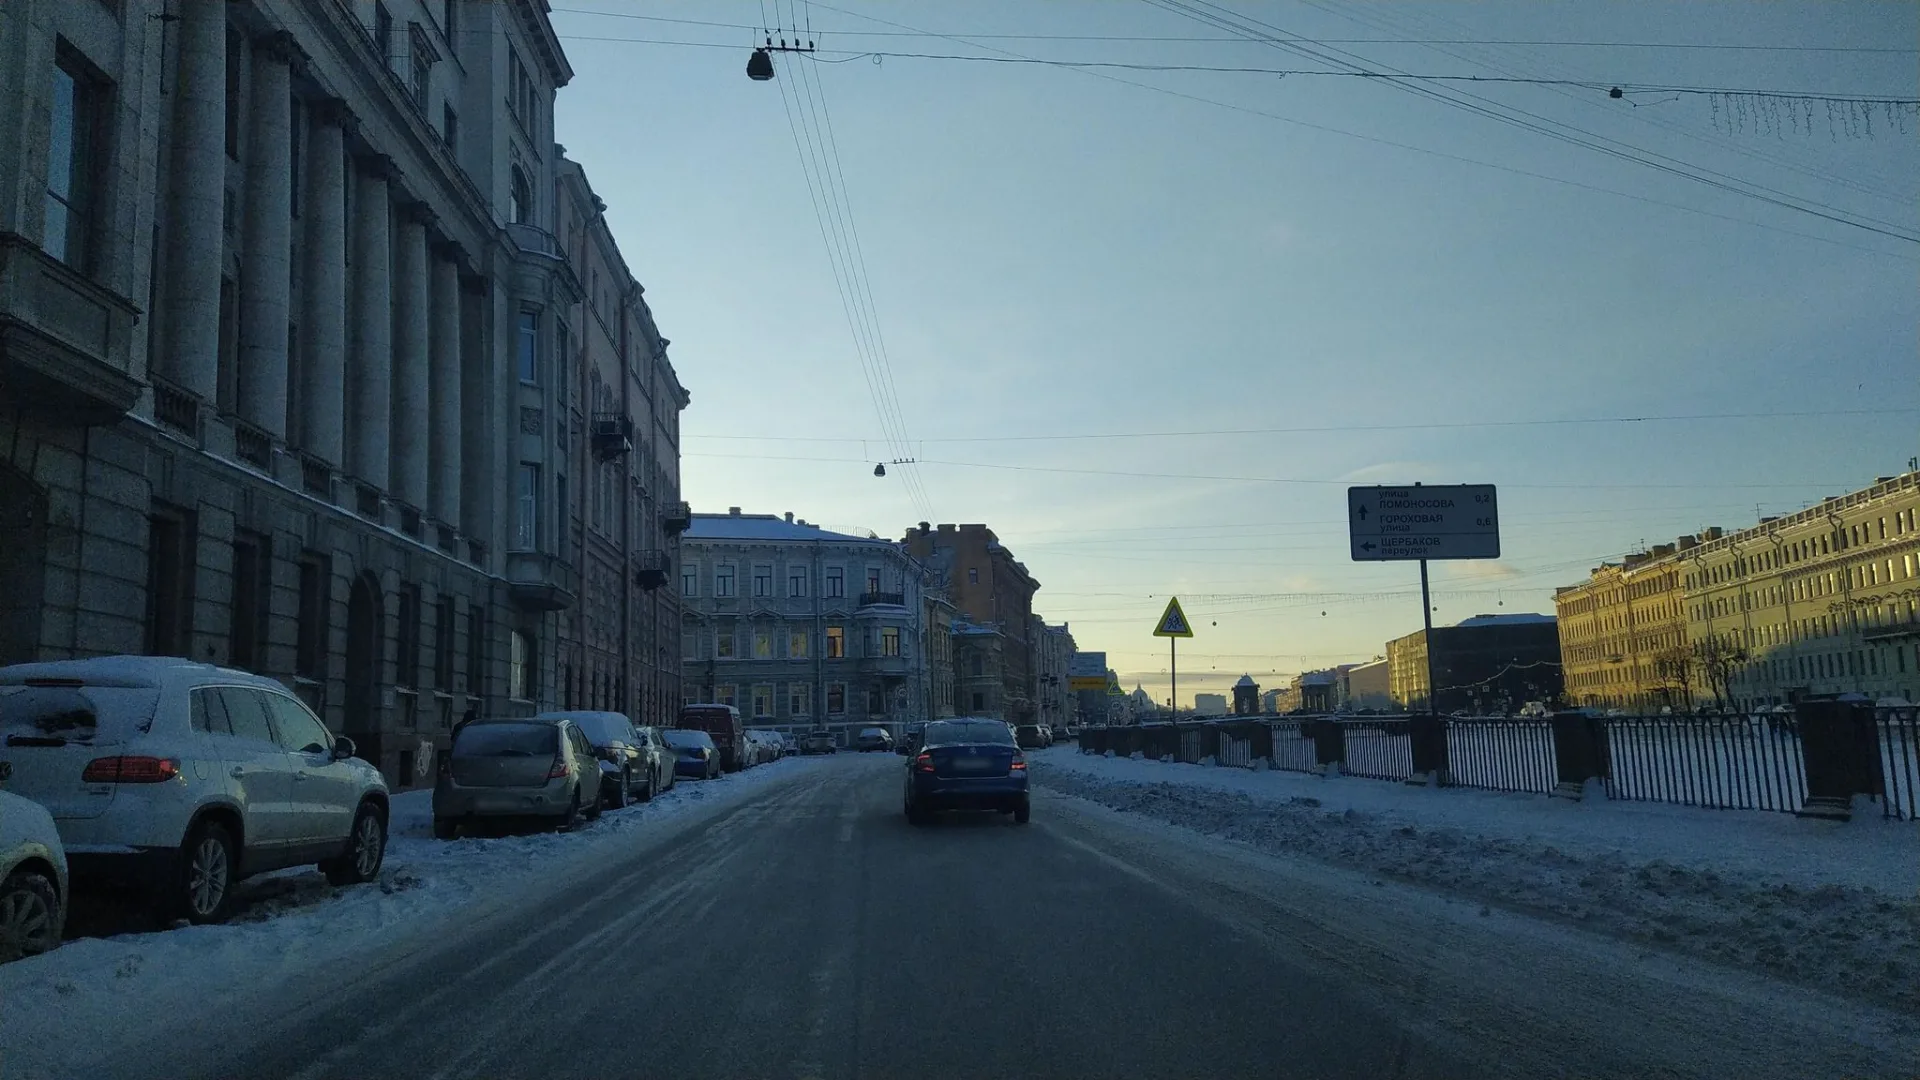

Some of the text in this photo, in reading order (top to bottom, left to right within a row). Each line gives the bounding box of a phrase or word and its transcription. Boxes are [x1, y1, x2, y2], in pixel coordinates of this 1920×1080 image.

[1378, 490, 1409, 499] улица
[1475, 494, 1490, 504] 0,2
[1379, 499, 1455, 509] ЛОМОНОСОВА
[1379, 514, 1443, 524] ГОРОХОВАЯ
[1380, 524, 1410, 533] улица
[1381, 537, 1441, 547] ЩЕРБАКОВ
[1381, 547, 1429, 556] переулок
